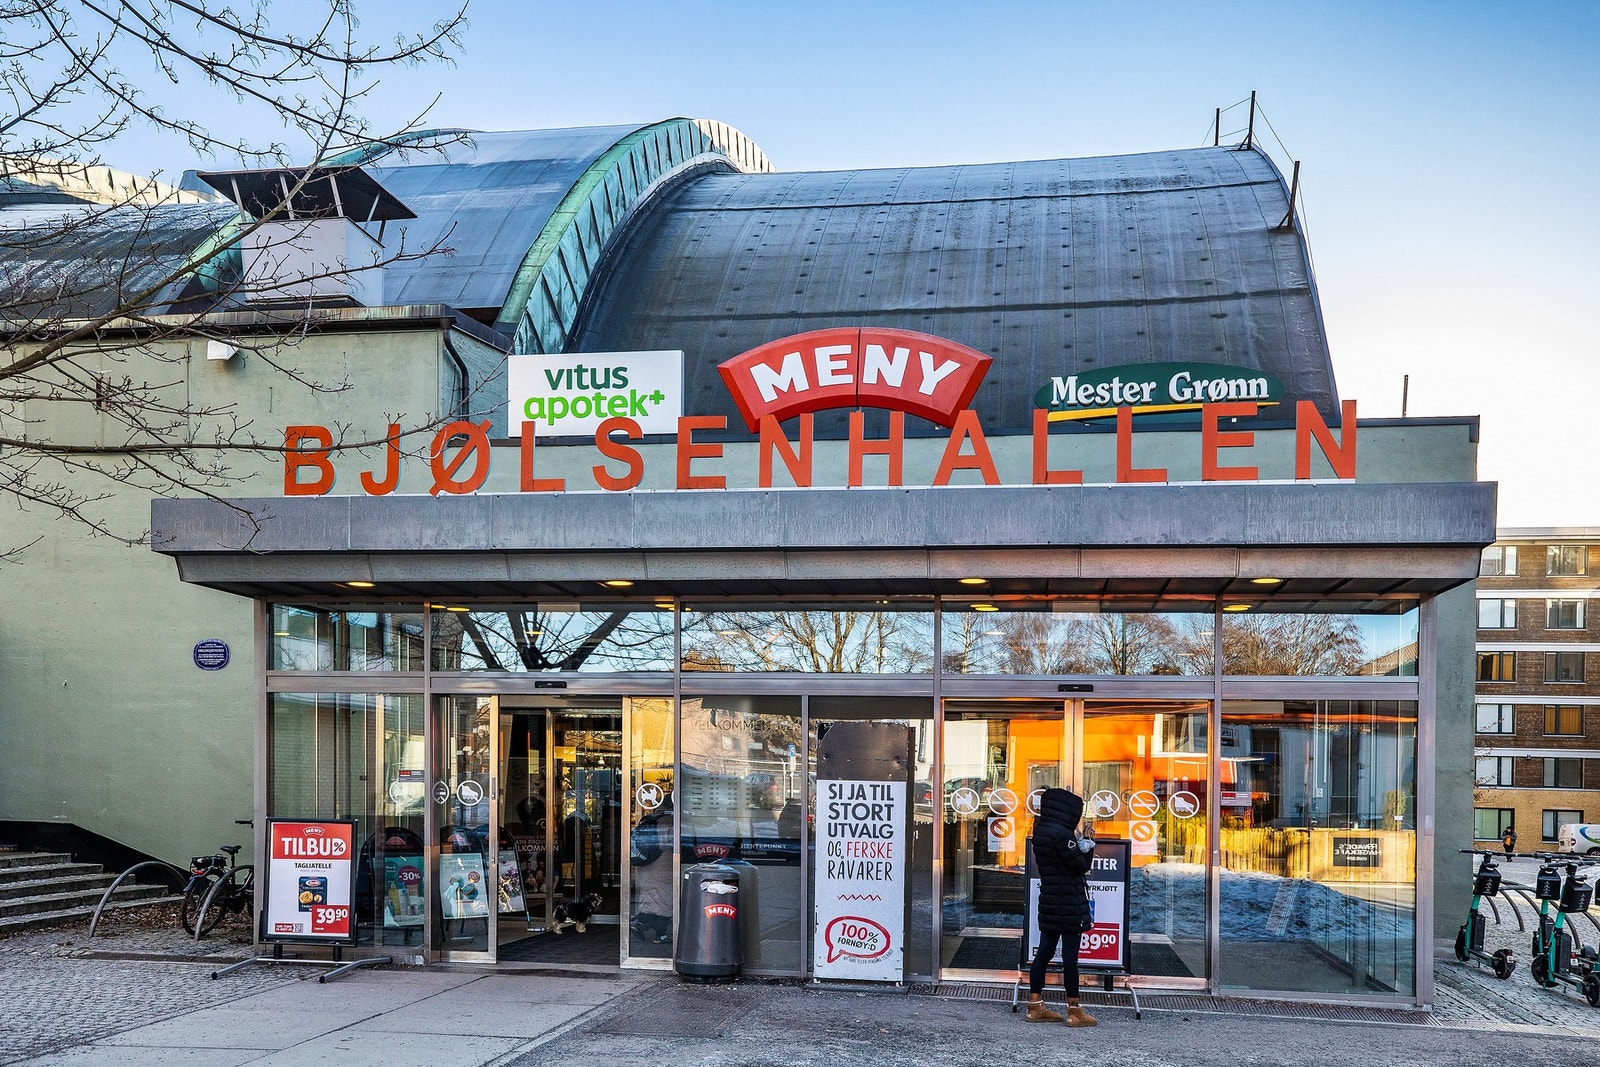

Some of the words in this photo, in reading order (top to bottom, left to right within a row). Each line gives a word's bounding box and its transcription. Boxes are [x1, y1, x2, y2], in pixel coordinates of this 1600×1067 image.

[544, 363, 630, 391] vitus
[748, 343, 961, 404] MENY
[1050, 373, 1157, 407] Mester
[1168, 370, 1270, 403] Grønn
[283, 399, 1358, 498] BJØLSENHALLEN
[828, 783, 843, 800] SI
[847, 783, 867, 801] JA
[869, 784, 894, 801] TIL
[828, 802, 895, 821] STORT
[827, 822, 894, 840] UTVALG
[697, 846, 726, 856] MENY
[827, 840, 842, 858] OG
[846, 841, 894, 859] FERSKE
[827, 855, 893, 882] RÅVARER
[1090, 857, 1118, 871] TTER
[708, 906, 735, 916] MENY
[841, 922, 879, 944] 100%
